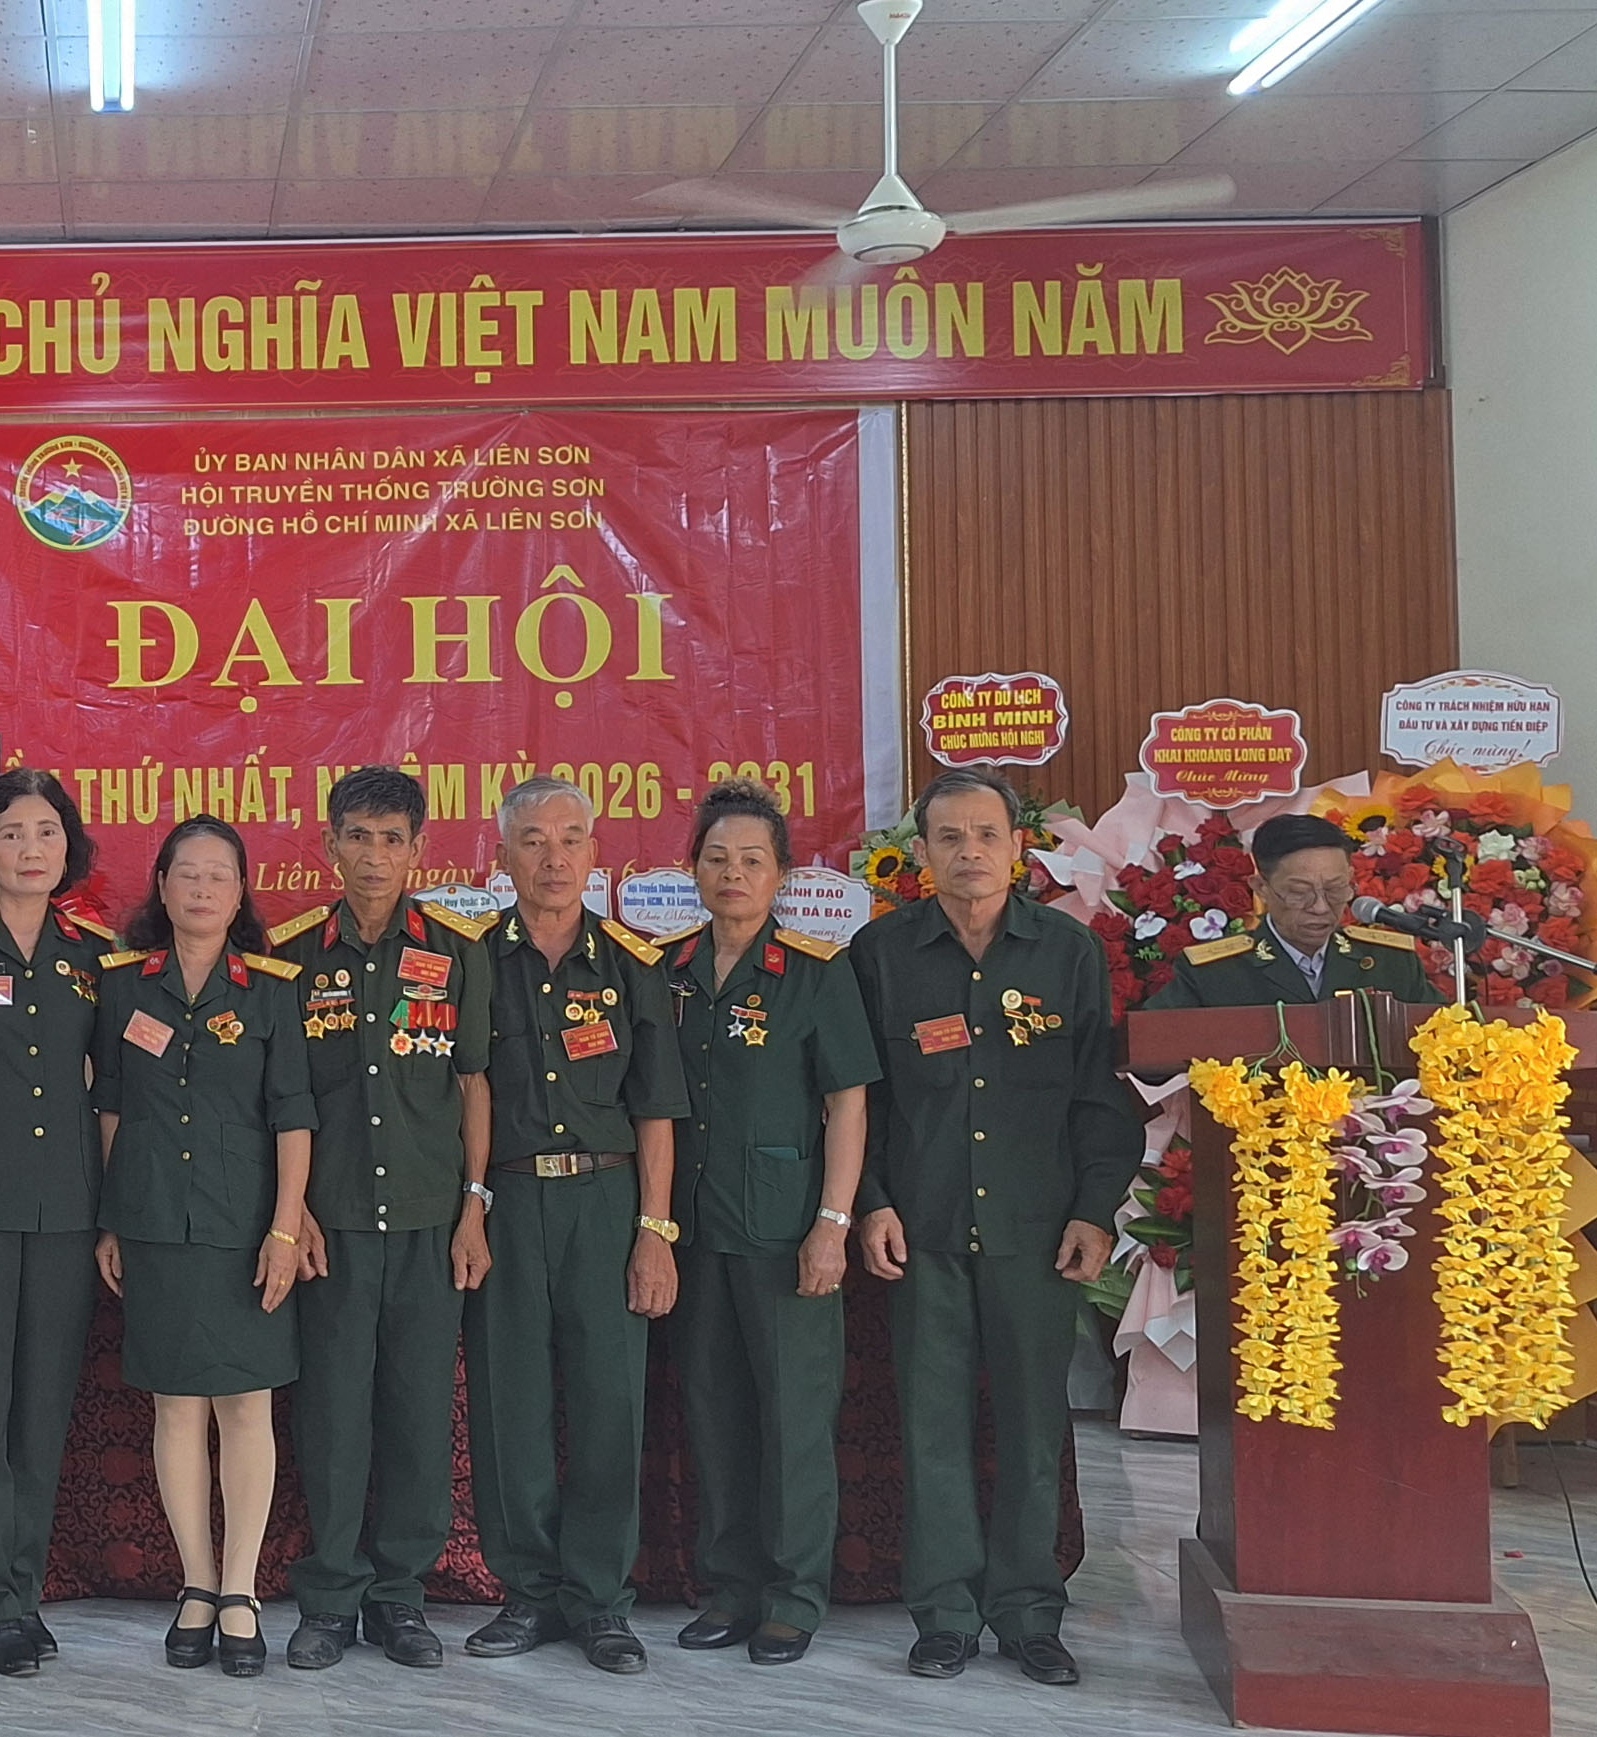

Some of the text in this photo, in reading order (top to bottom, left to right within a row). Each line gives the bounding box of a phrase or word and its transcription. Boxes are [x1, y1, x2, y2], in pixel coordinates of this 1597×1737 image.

[148, 279, 370, 372] NGHĨA
[392, 274, 544, 384] VIỆT
[570, 287, 737, 365] NAM
[765, 266, 985, 362] MUÔN
[1012, 263, 1183, 358] NĂM
[194, 443, 591, 473] ỦY BAN NHÂN DÂN XÃ LIÊN SƠN
[181, 475, 605, 508] HỘI TRUYỀN THỐNG TRƯỜNG SƠN
[184, 507, 603, 538] ĐƯỜNG HỒ CHÍ MINH XÃ LIÊN SƠN
[105, 565, 675, 714] ĐẠI HỘI
[940, 688, 1042, 709] CÔNG TY DU LỊCH
[1396, 699, 1550, 713] CÔNG TY TRÁCH NHIỆM HỮU HẠN
[933, 709, 1053, 729] BÌNH MINH
[1398, 717, 1419, 730] ĐẦU
[1421, 719, 1434, 730] TƯ
[1435, 718, 1448, 730] VÀ
[1450, 718, 1469, 731] XÂY
[1472, 720, 1499, 733] DỰNG
[940, 728, 1045, 750] CHÚC MỪNG HỘI NGHỊ
[1171, 725, 1201, 742] CÔNG
[1204, 727, 1219, 741] TY
[1154, 749, 1182, 763] KHAI
[1234, 748, 1266, 762] LONG
[74, 755, 164, 824] THỨ
[174, 746, 301, 830] NHẤT,
[707, 761, 815, 817] 31
[254, 861, 321, 891] Liên
[816, 888, 844, 900] ĐẠO
[824, 907, 852, 920] BẠC
